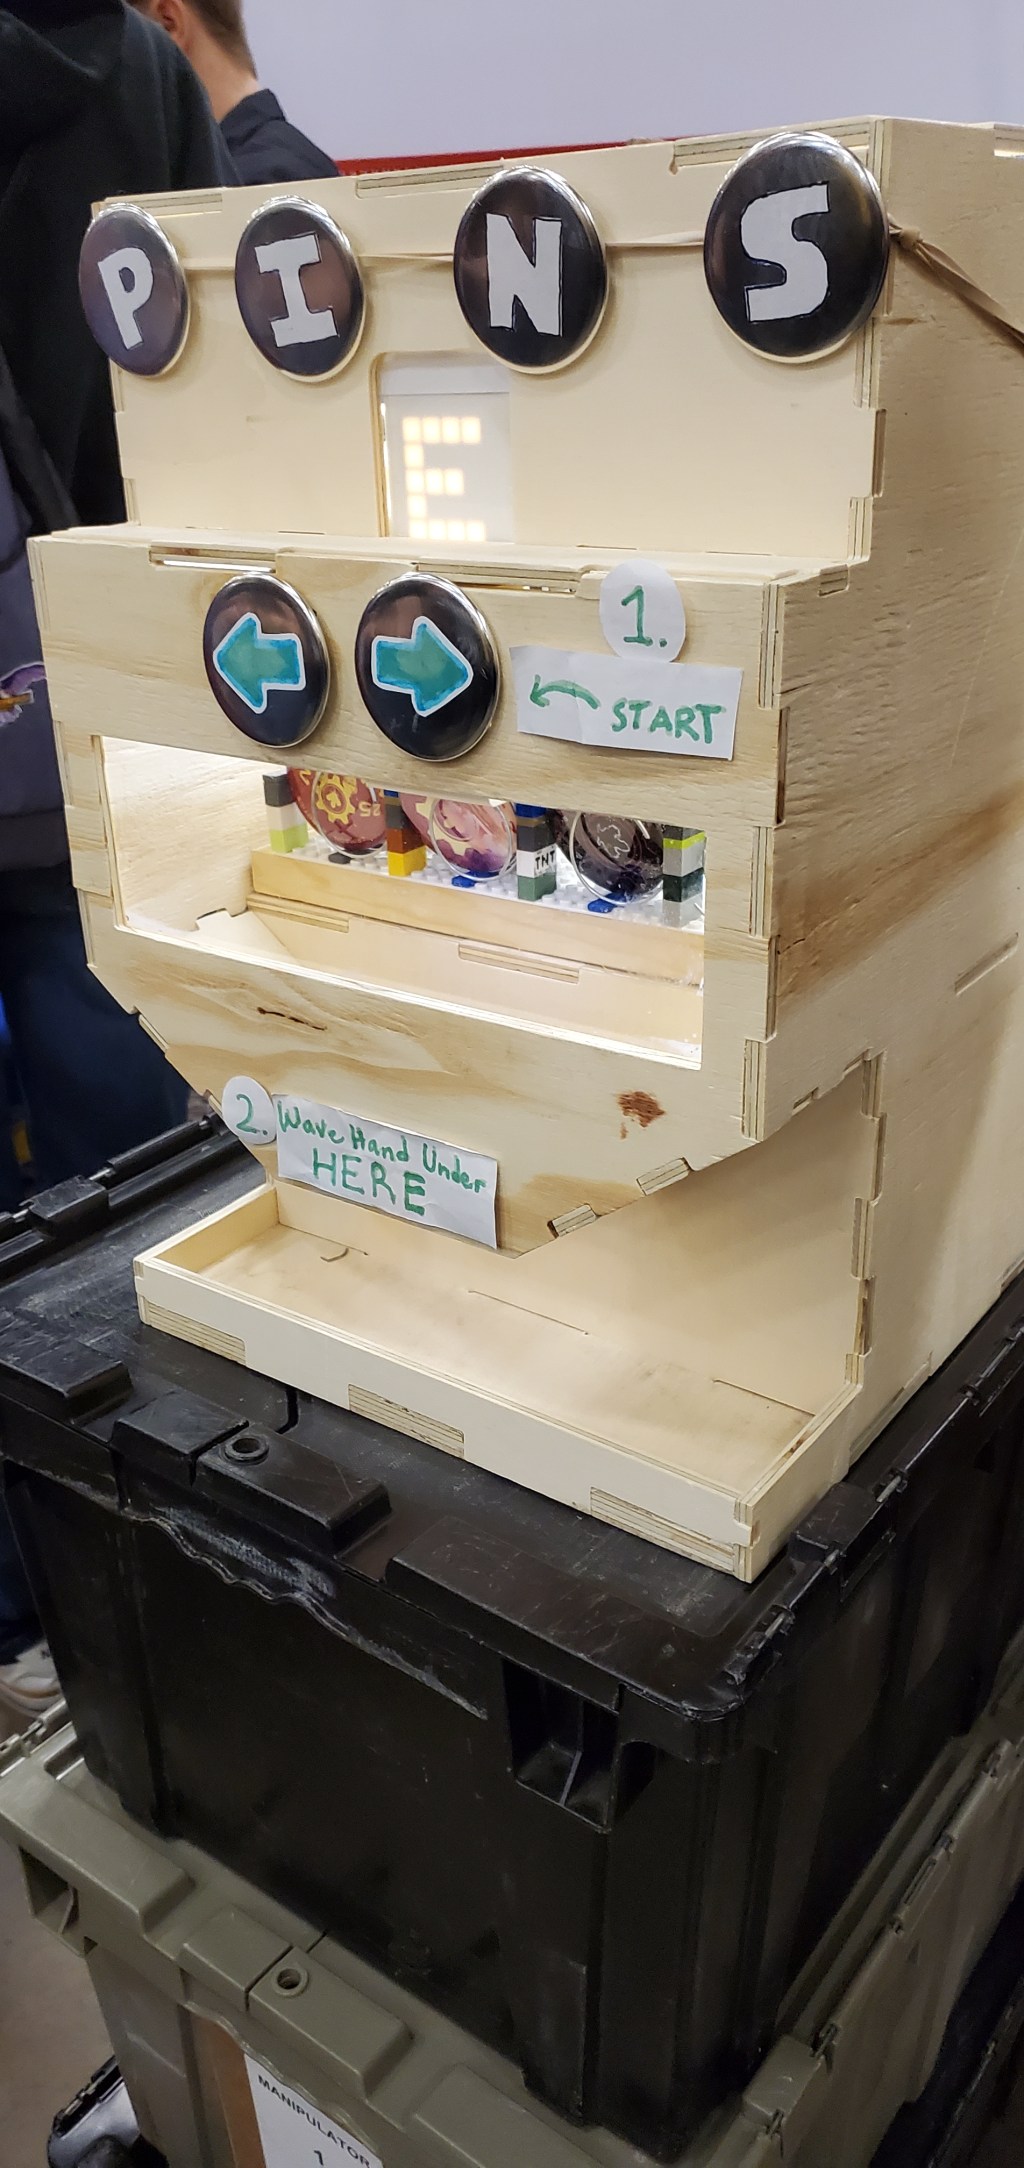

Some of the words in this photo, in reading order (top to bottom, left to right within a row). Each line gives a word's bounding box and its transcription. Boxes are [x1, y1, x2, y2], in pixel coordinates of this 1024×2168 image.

[97, 181, 830, 350] PINS
[402, 416, 486, 541] E
[620, 585, 668, 648] 1.
[611, 697, 727, 744] START
[535, 850, 555, 870] TNT
[236, 1093, 268, 1136] 2.
[277, 1100, 345, 1144] Wave
[349, 1124, 410, 1163] Hand
[422, 1142, 488, 1194] Under
[312, 1147, 426, 1217] HERE
[258, 2074, 371, 2168] MANIPULATOR
